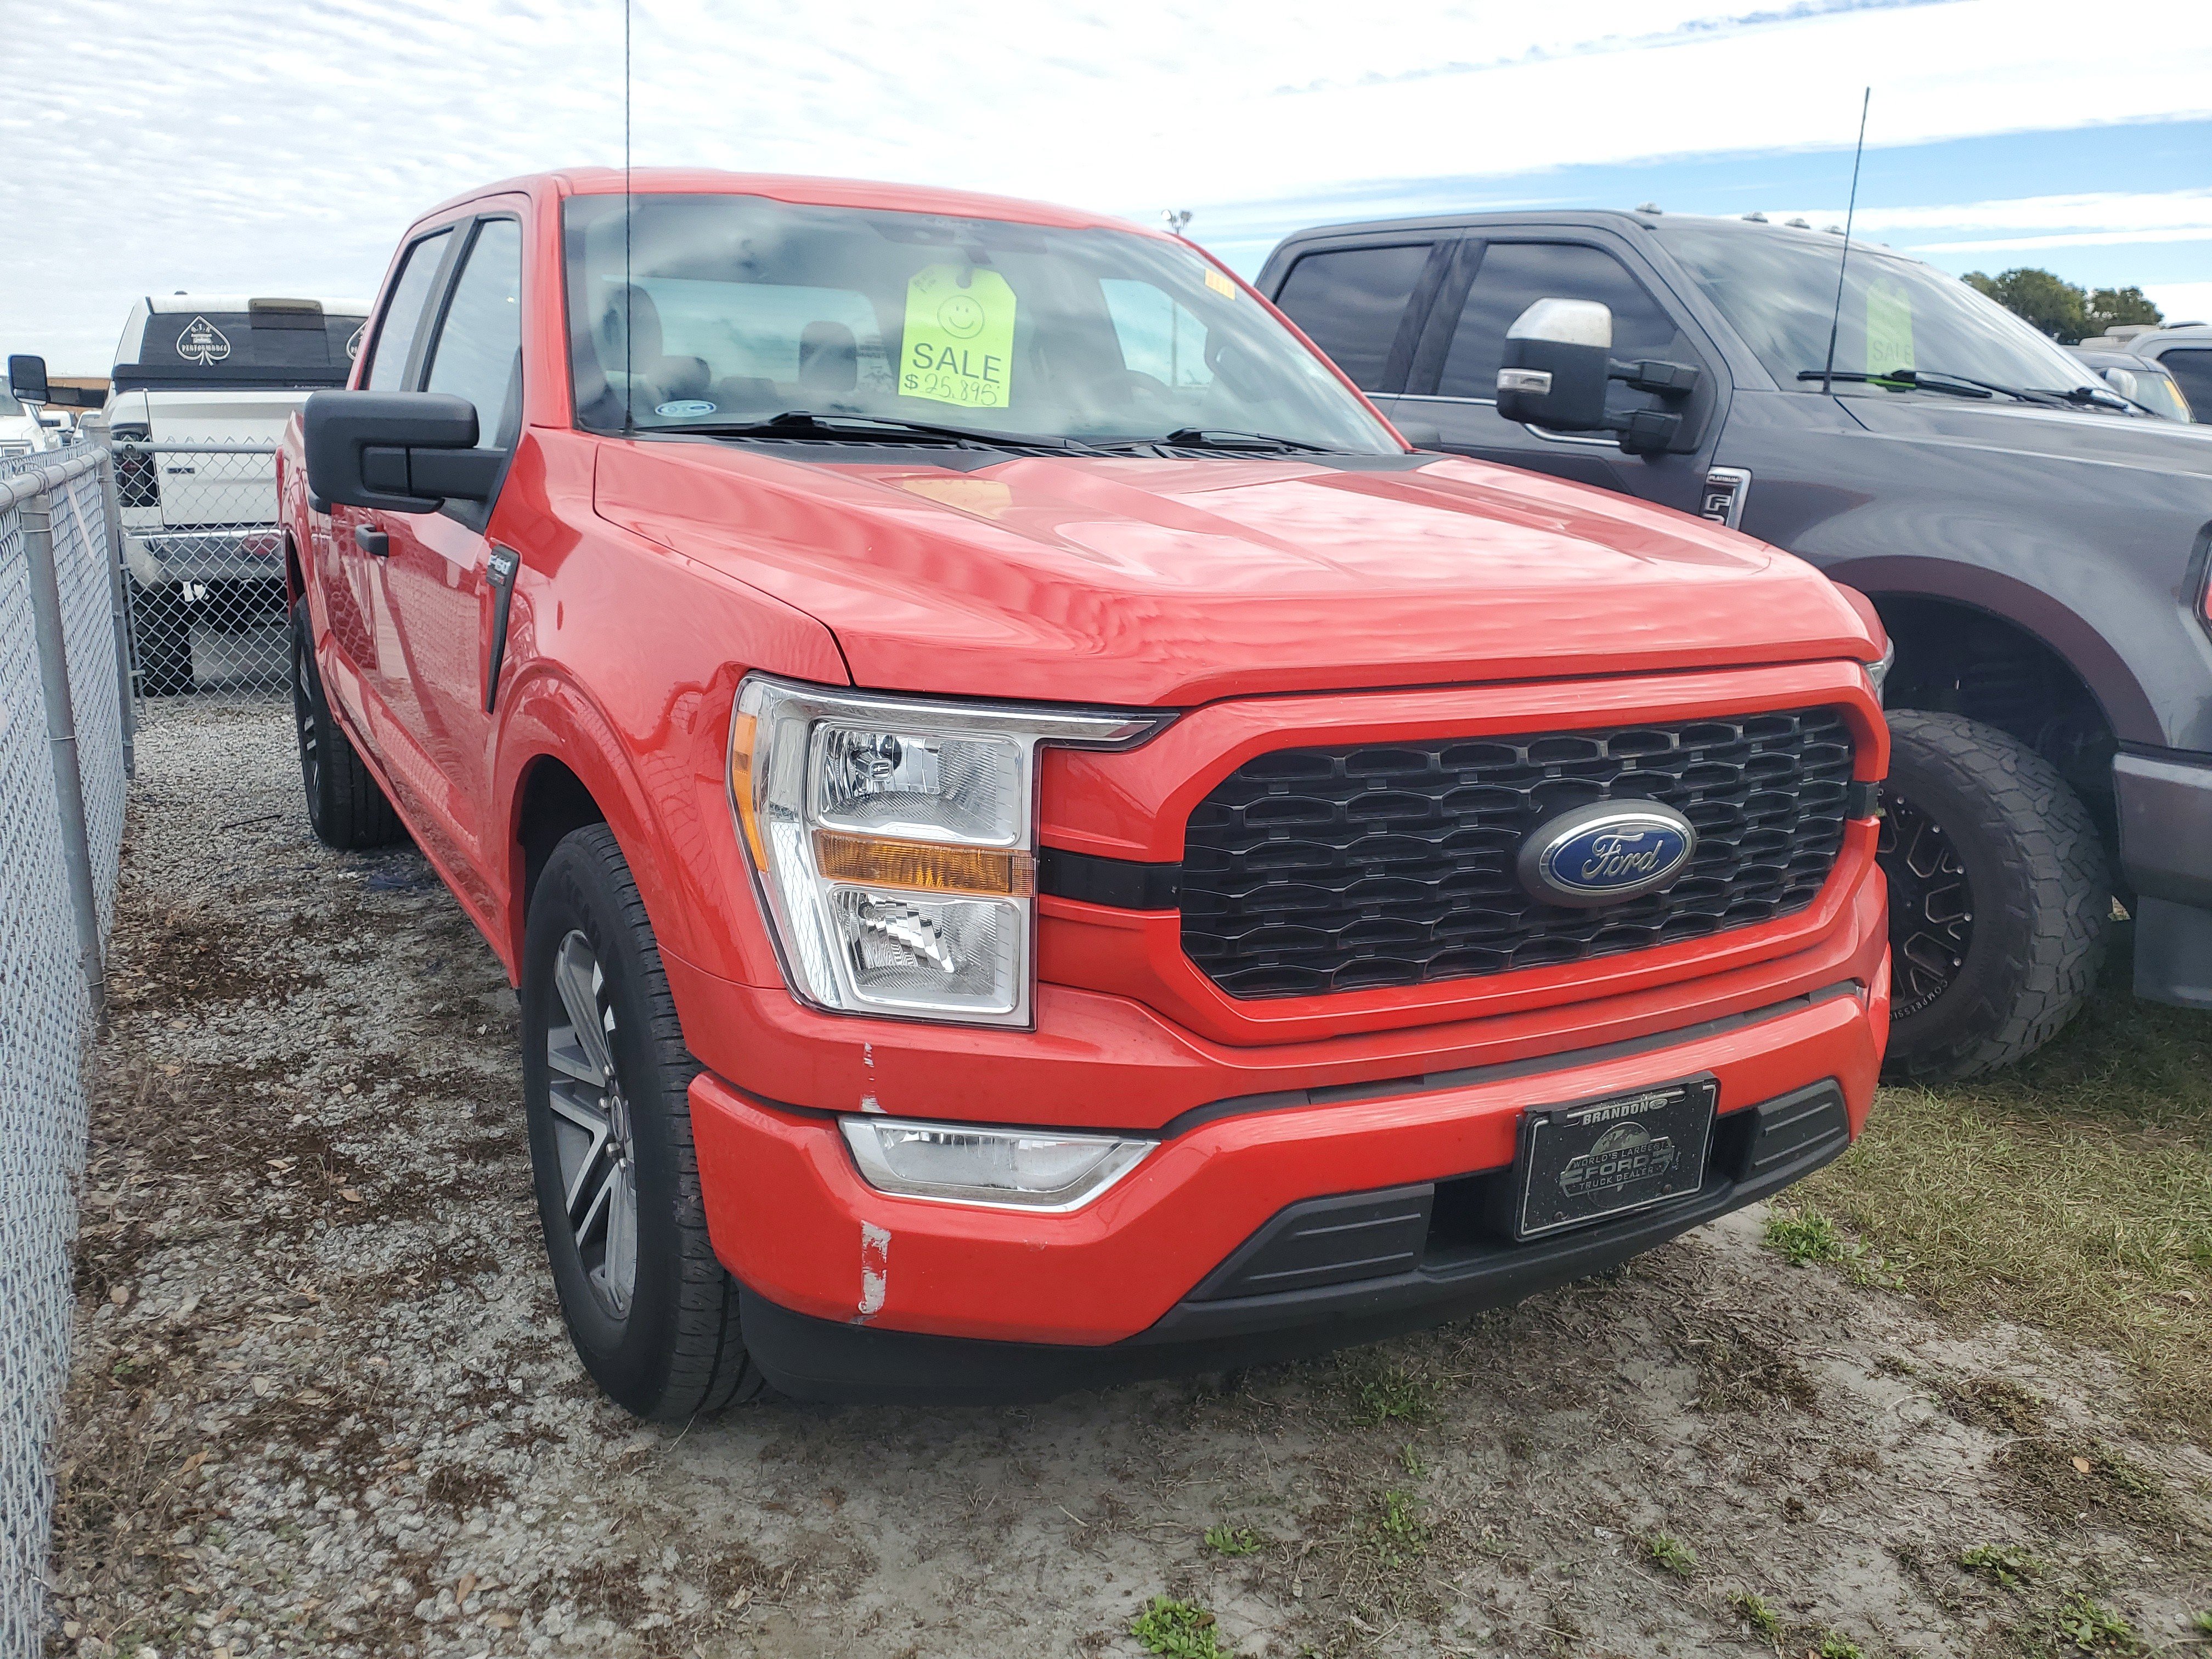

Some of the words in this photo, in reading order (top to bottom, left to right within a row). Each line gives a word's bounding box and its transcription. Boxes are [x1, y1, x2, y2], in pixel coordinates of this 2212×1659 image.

[912, 342, 1002, 383] SALE
[1581, 832, 1663, 881] Ford
[1583, 1101, 1650, 1125] BRANDON
[1573, 1152, 1618, 1169] WORLD'S
[1621, 1141, 1667, 1157] LARGEST
[1585, 1154, 1650, 1180] FORD
[1579, 1176, 1613, 1190] TRUCK
[1616, 1166, 1654, 1182] DEALER
